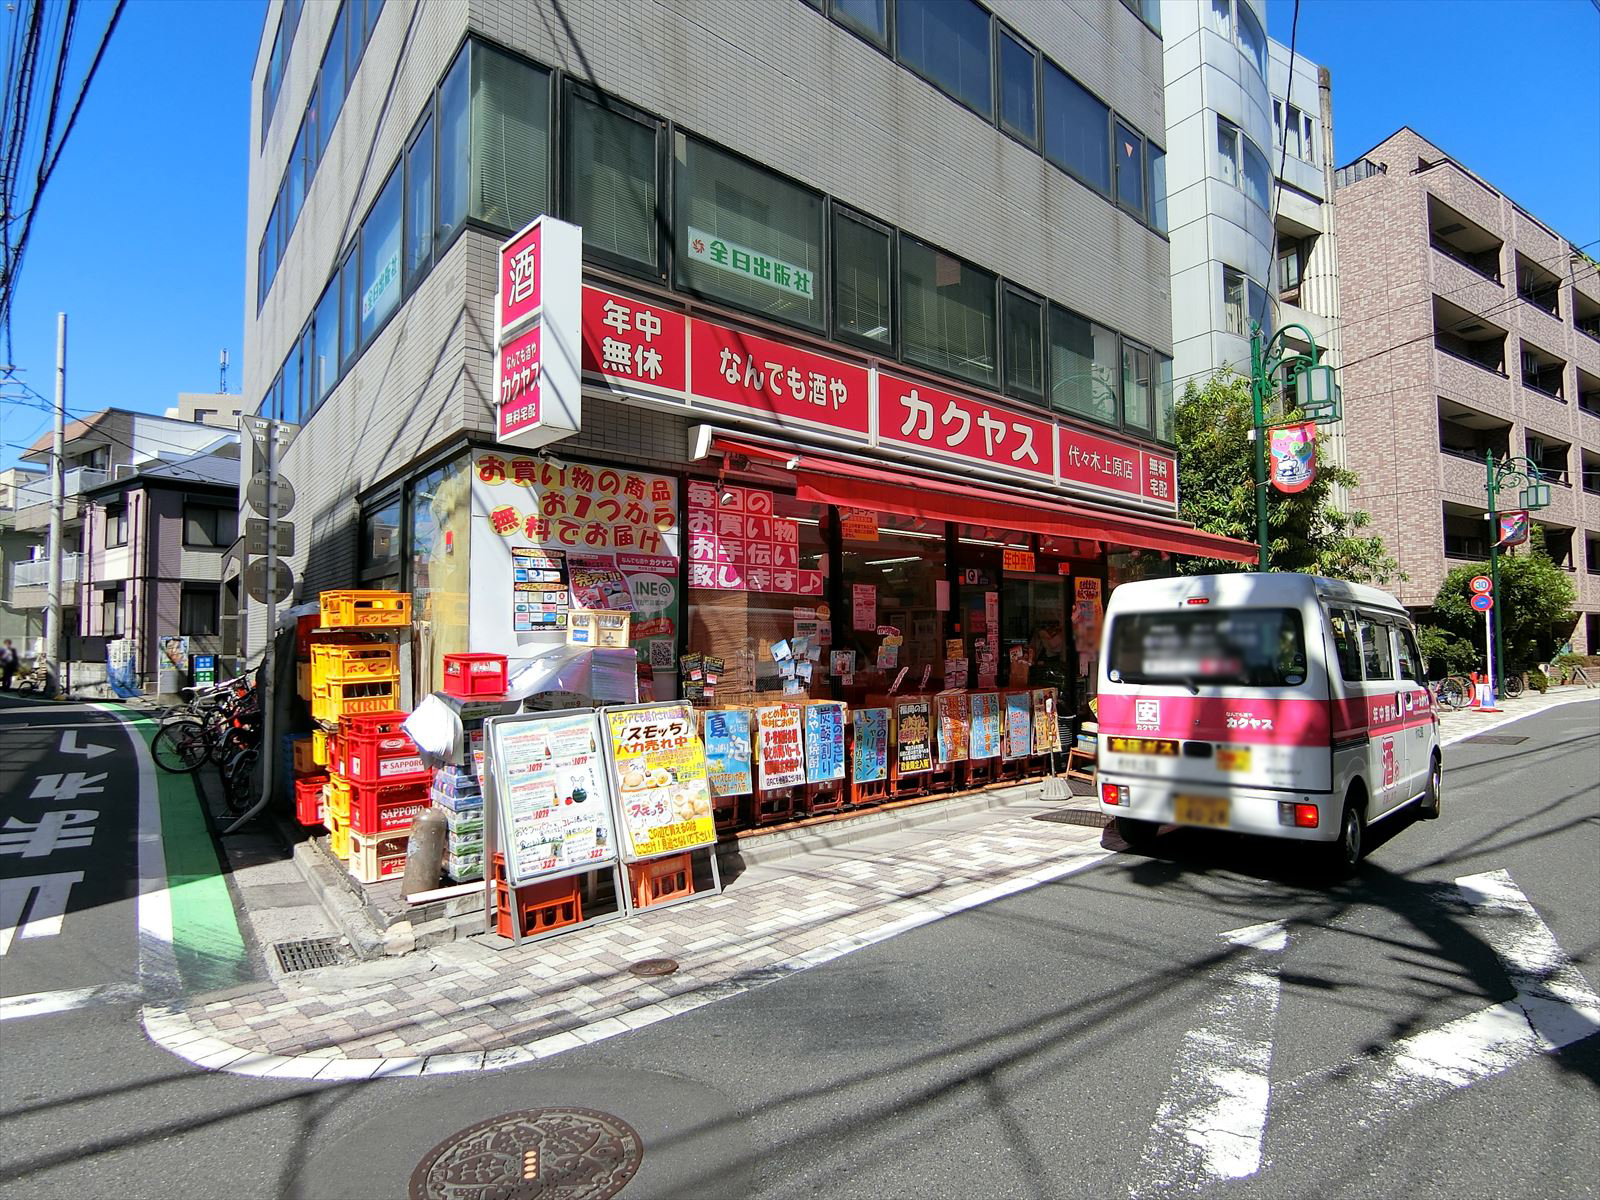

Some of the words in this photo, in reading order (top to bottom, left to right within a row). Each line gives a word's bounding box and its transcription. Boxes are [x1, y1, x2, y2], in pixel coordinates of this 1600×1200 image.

[508, 243, 537, 307] 酒
[710, 241, 812, 294] 全日出版社
[602, 300, 662, 342] 年中
[506, 344, 537, 370] なんでも酒や
[602, 338, 663, 380] 無休
[501, 361, 541, 405] カクヤス
[720, 347, 848, 410] なんでも酒や
[505, 402, 536, 426] 無料宅配
[900, 389, 1039, 465] カクヤス
[1069, 445, 1133, 480] 代々木上原店
[1149, 457, 1168, 479] 無料
[479, 457, 674, 502] お買い物の商品
[1150, 477, 1168, 498] 宅配
[543, 491, 675, 529] お1つから
[688, 482, 772, 514] 毎日の
[490, 507, 660, 553] 無料でお届け
[689, 514, 797, 543] お買い物
[689, 535, 797, 565] お手伝い
[1004, 551, 1035, 571] 年中無休
[650, 559, 673, 568] カクヤス
[633, 581, 671, 597] INE@
[1475, 581, 1487, 589] 30
[359, 613, 400, 623] ホッピー
[346, 662, 387, 673] ホッピー
[344, 700, 389, 713] KIRIN
[1138, 702, 1158, 722] 安
[708, 713, 729, 738] 夏
[1137, 724, 1160, 732] カクヤス
[1227, 717, 1274, 730] カクヤス
[617, 736, 688, 755] バカ売れ中
[390, 759, 424, 770] SAPPORO
